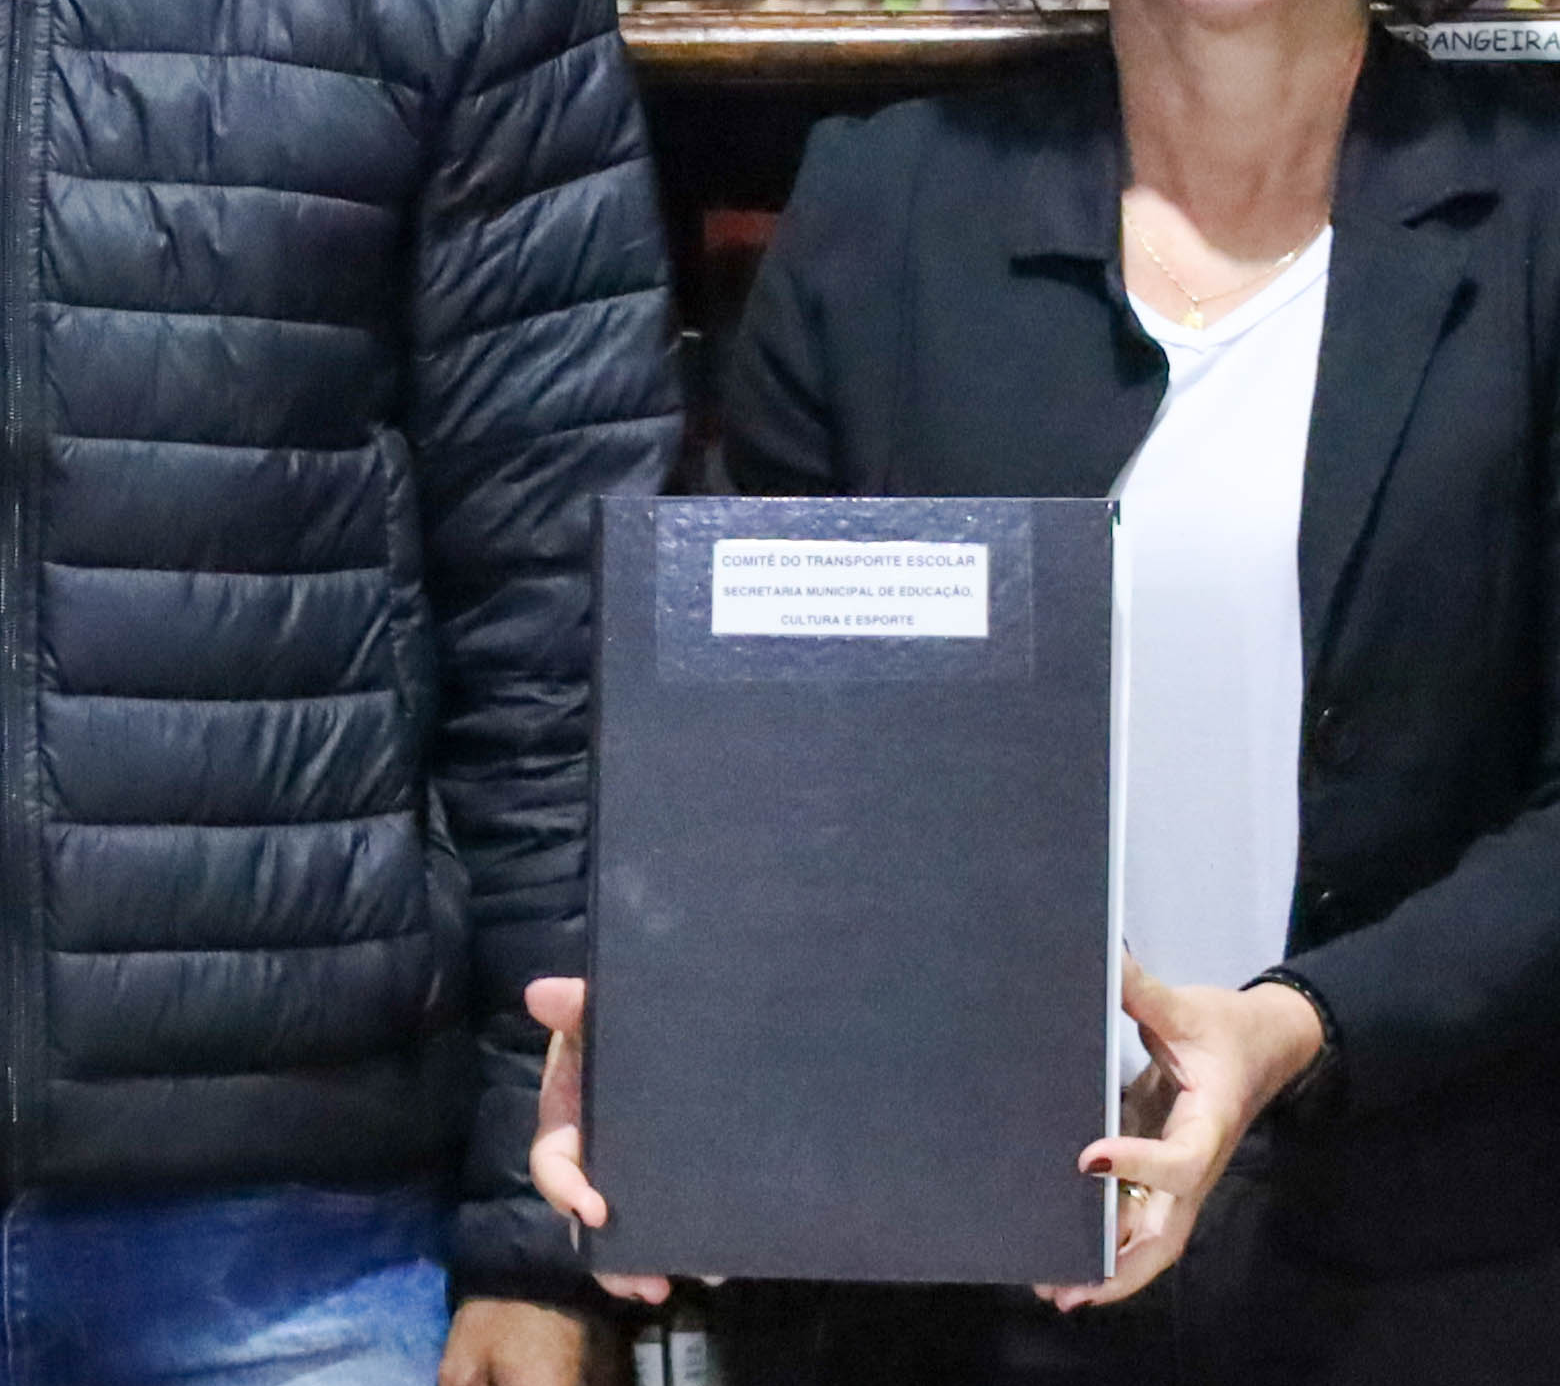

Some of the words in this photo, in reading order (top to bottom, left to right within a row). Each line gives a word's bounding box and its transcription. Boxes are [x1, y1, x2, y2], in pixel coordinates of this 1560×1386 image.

[1415, 29, 1560, 51] RANGEIRA
[781, 556, 801, 567] DO
[807, 555, 902, 567] TRANSPORTE
[907, 556, 975, 567] ESCOLAR
[723, 586, 802, 597] SECRETARIA
[806, 586, 873, 597] MUNICIPAL
[879, 586, 894, 597] DE
[781, 615, 840, 626] CULTURA
[844, 615, 851, 626] E
[855, 615, 915, 626] ESPORTE
